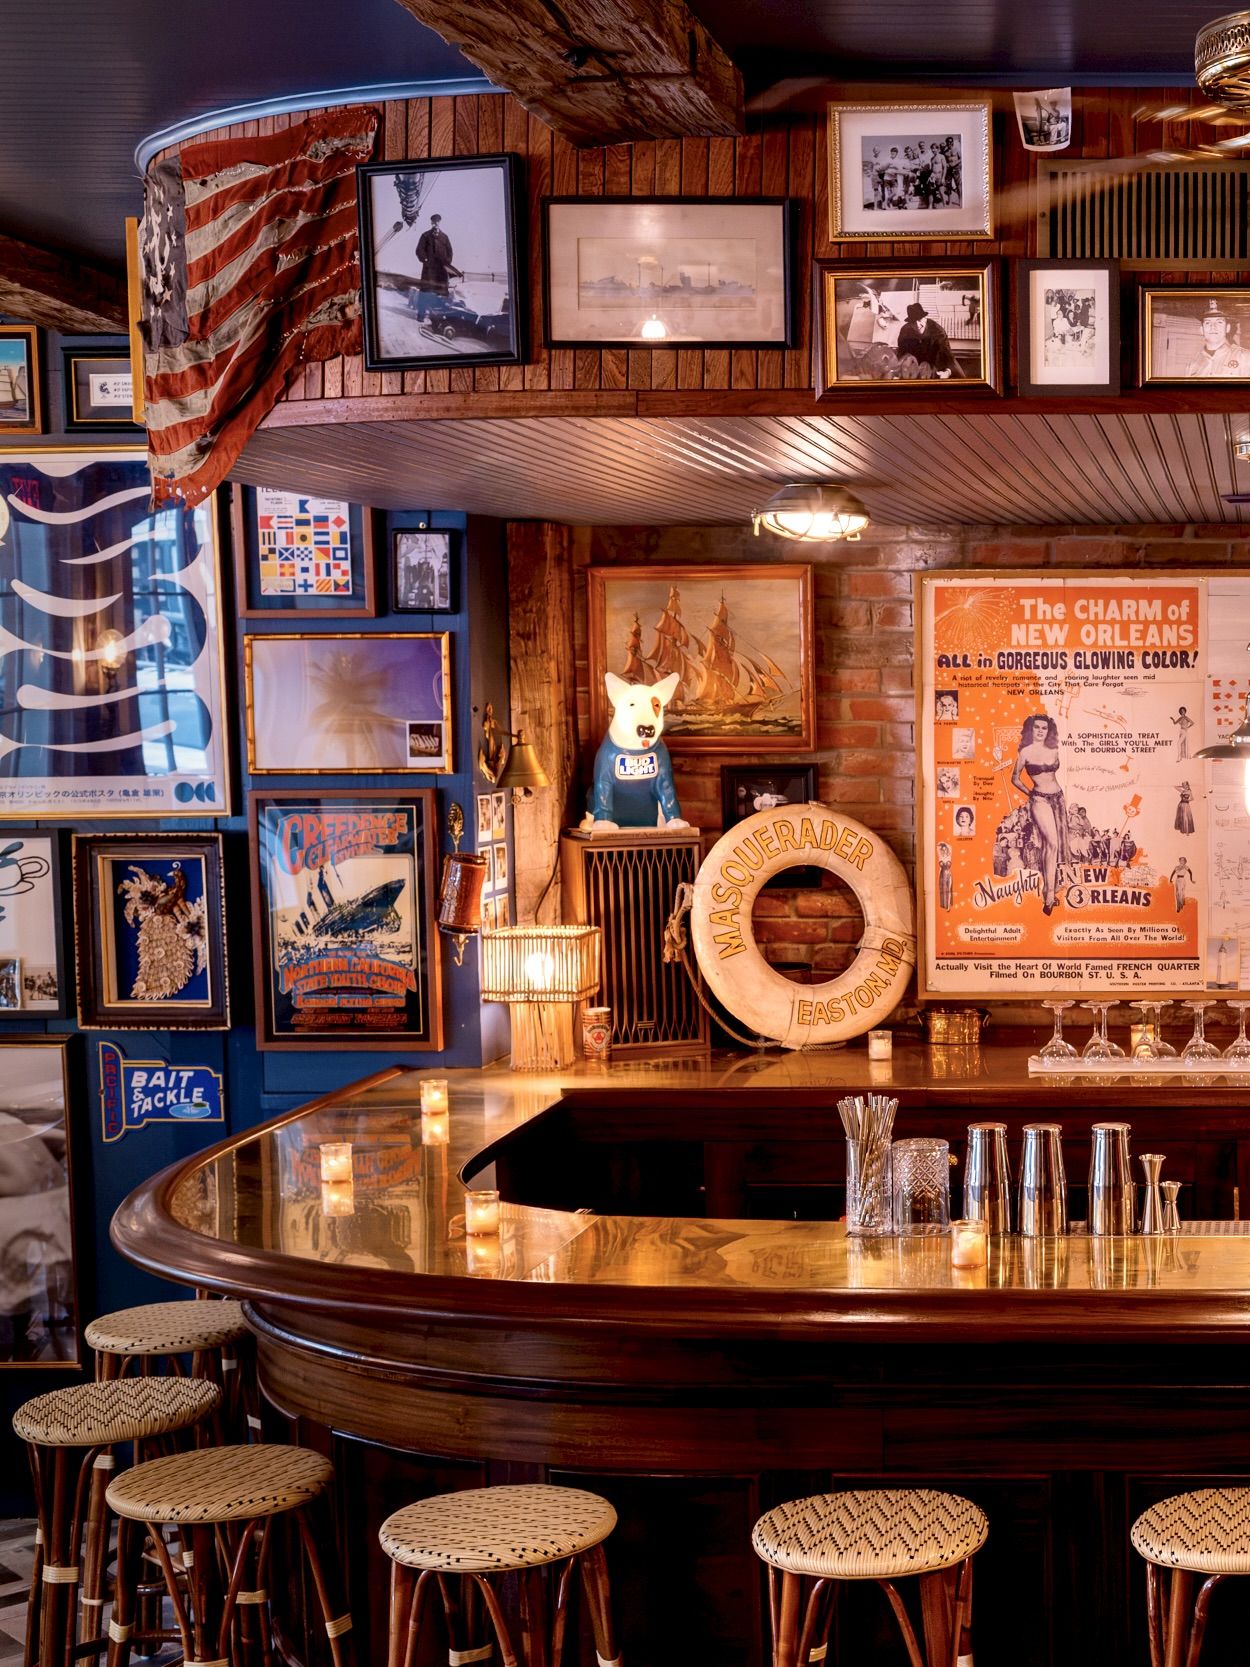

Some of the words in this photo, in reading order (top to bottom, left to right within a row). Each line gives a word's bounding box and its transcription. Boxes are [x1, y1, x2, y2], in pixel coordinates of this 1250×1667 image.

[1020, 598, 1067, 620] The
[1074, 599, 1162, 621] CHARM
[1167, 599, 1190, 621] of
[1011, 624, 1069, 646] NEW
[1080, 624, 1194, 646] ORLEANS
[937, 654, 972, 669] ALL
[977, 652, 993, 669] in
[997, 651, 1068, 670] GORGEOUS
[1073, 651, 1135, 670] GLOWING
[1141, 650, 1199, 669] COLOR!
[985, 674, 1008, 683] revelry
[1064, 674, 1089, 683] roaring
[1092, 673, 1121, 683] laughter
[1143, 673, 1156, 681] mid
[1047, 681, 1062, 690] City
[1102, 681, 1124, 689] Forgot
[625, 756, 651, 766] BUD
[619, 765, 656, 776] LIGHT
[283, 813, 408, 875] CREEDENCE
[305, 828, 398, 870] CLEARWATER
[709, 818, 873, 960] MASQUERADER
[974, 870, 1040, 908] Naughty
[1058, 862, 1108, 885] NEW
[964, 927, 997, 935] Delightful
[1003, 927, 1021, 935] Adult
[1064, 926, 1092, 934] Exactly
[1095, 926, 1104, 934] As
[1107, 926, 1124, 934] Seen
[1127, 926, 1137, 934] By
[1139, 926, 1169, 934] Millions
[1171, 926, 1180, 934] Of
[1056, 934, 1085, 942] Visitors
[1088, 934, 1108, 942] From
[1111, 934, 1121, 942] All
[1124, 934, 1141, 942] Over
[1144, 934, 1158, 942] The
[1161, 934, 1185, 942] World!
[935, 963, 969, 972] Actually
[974, 963, 993, 971] Visit
[998, 963, 1011, 971] the
[1015, 963, 1038, 971] Heart
[1042, 963, 1052, 971] Of
[1057, 963, 1082, 971] World
[1086, 963, 1113, 971] Famed
[1117, 963, 1153, 971] FRENCH
[1158, 963, 1200, 971] QUARTER
[989, 971, 1018, 979] Filmed
[1022, 971, 1035, 979] On
[1040, 971, 1083, 979] BOURBON
[1088, 971, 1102, 979] ST.
[1106, 971, 1115, 979] U.
[1120, 971, 1129, 979] S.
[1133, 971, 1142, 979] A.
[797, 971, 892, 1025] EASTON,
[876, 937, 908, 977] MD.
[131, 1071, 195, 1088] BAIT
[130, 1087, 204, 1118] TACKLE
[132, 1088, 145, 1102] &
